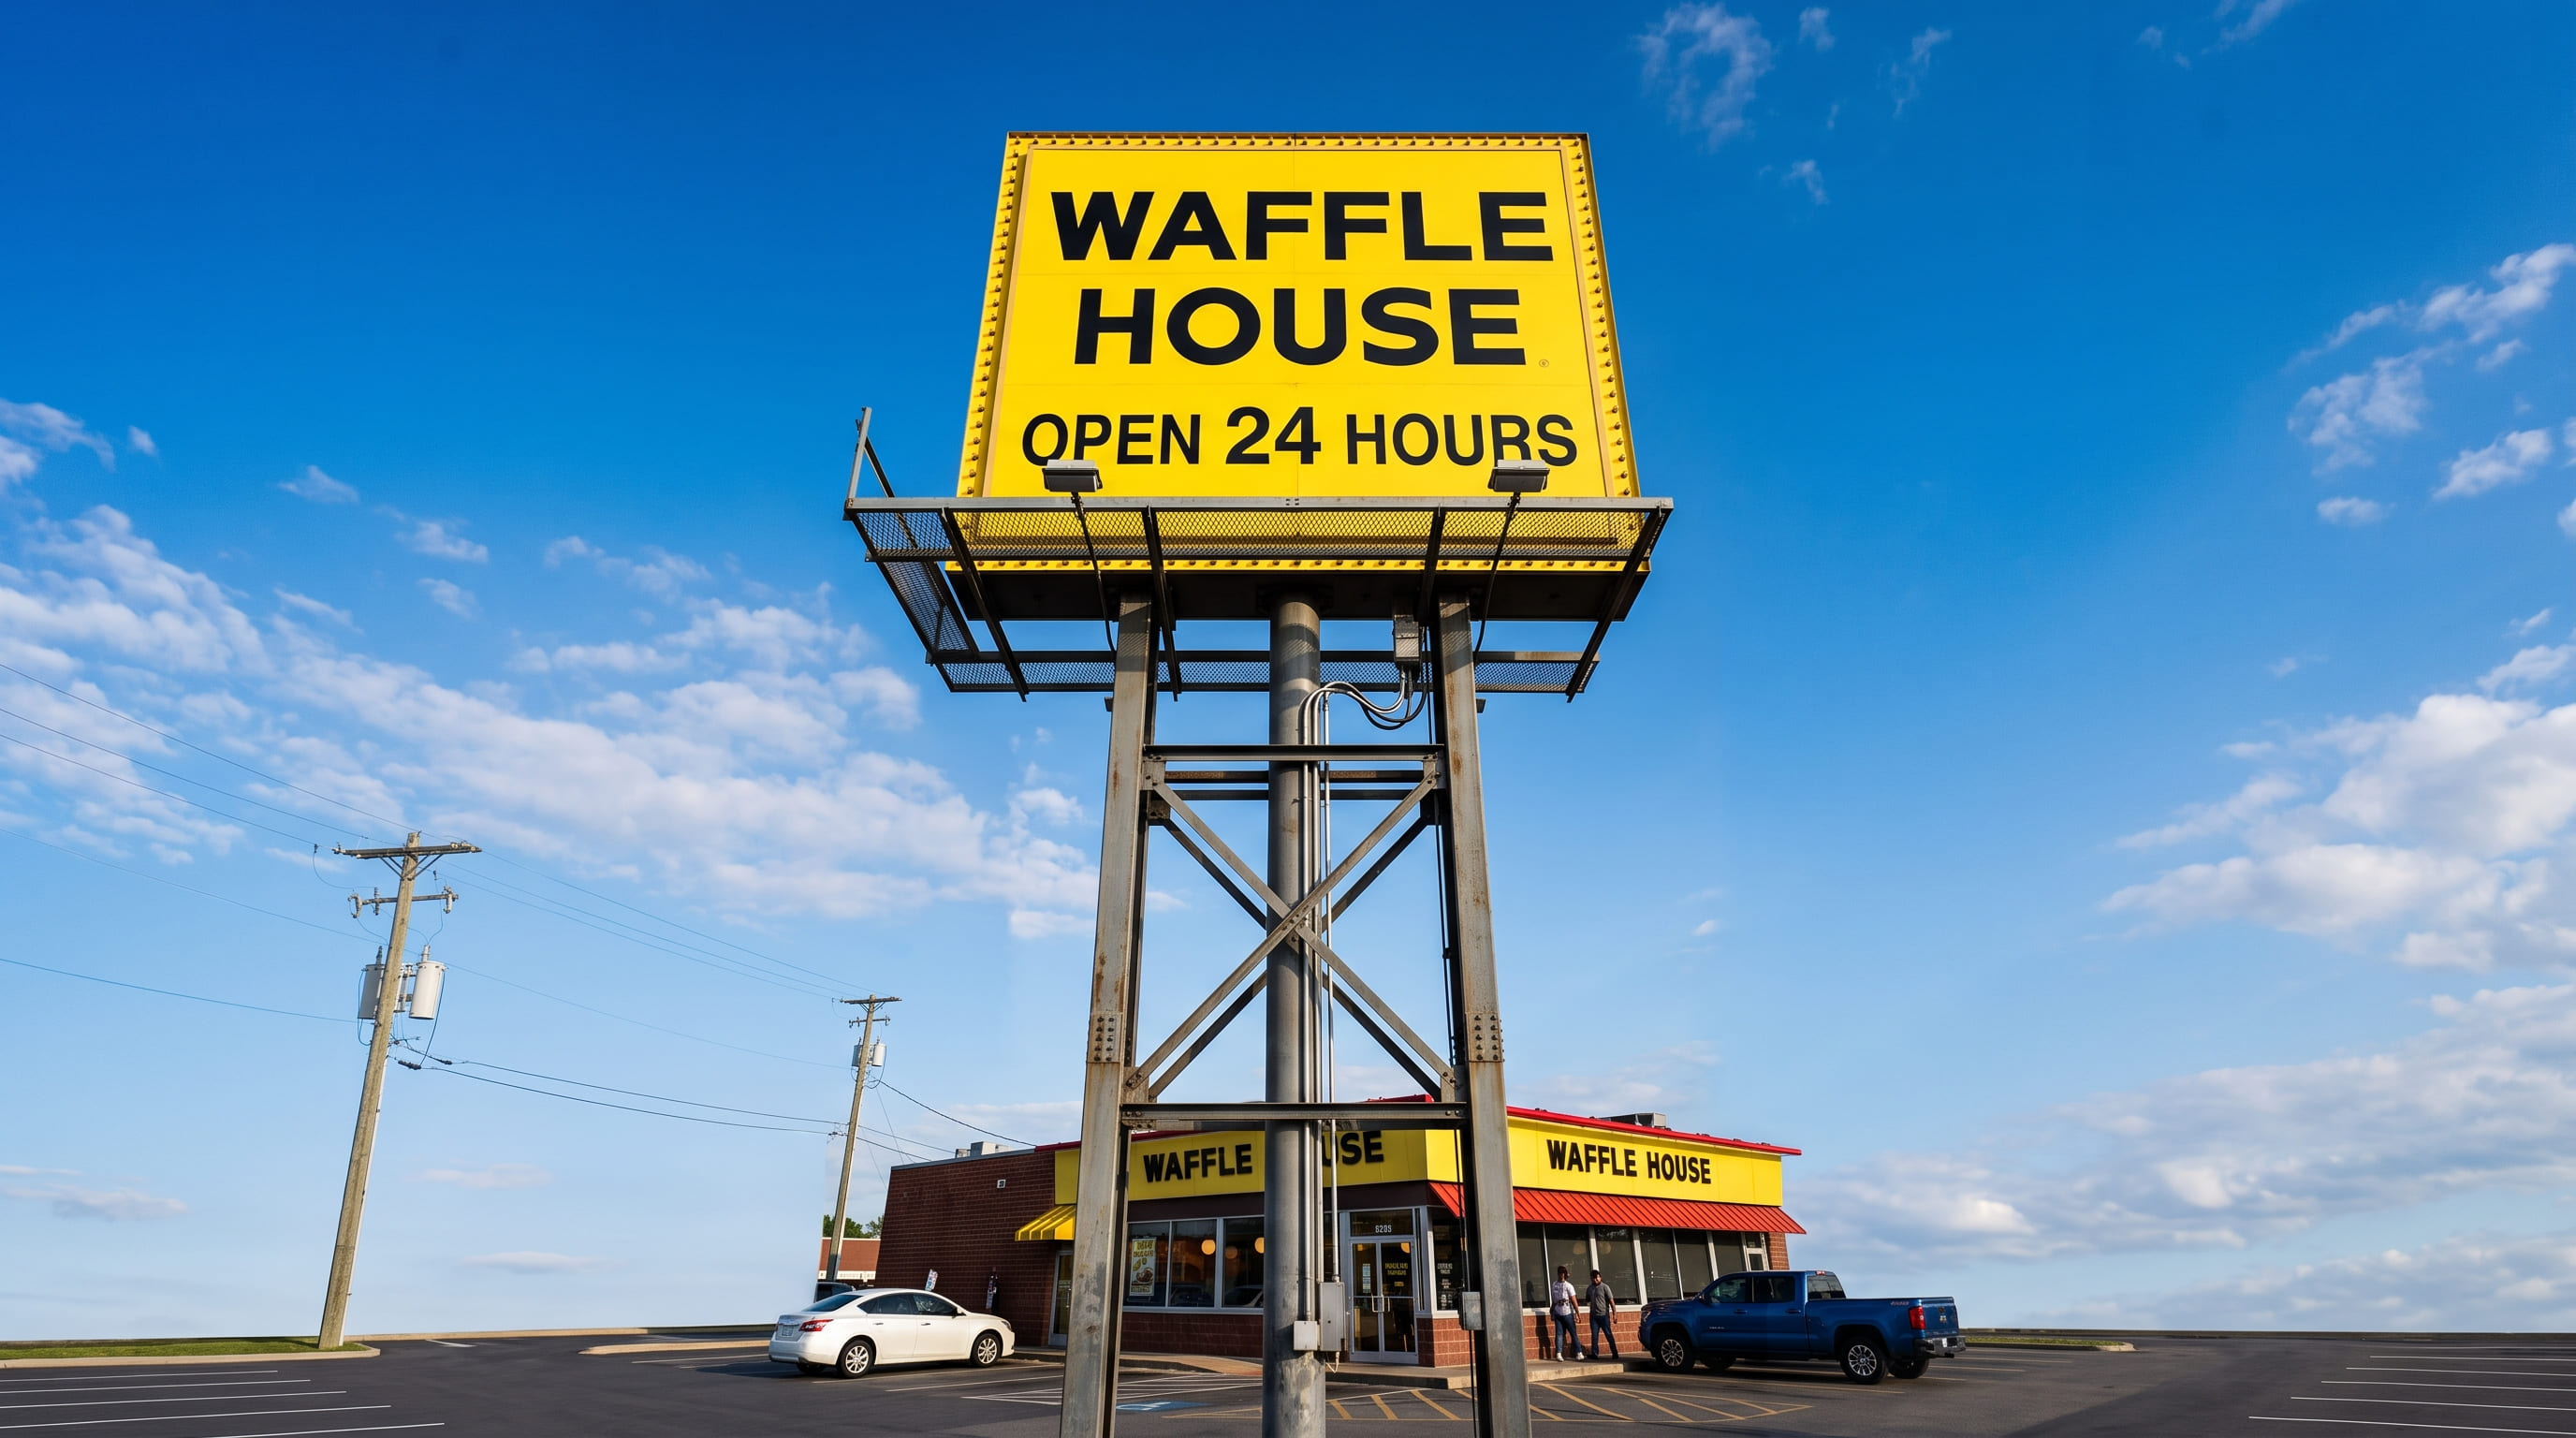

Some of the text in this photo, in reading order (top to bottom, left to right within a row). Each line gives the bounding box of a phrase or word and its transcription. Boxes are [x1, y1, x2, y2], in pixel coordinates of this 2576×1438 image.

[1050, 191, 1554, 261] WAFFLE
[1074, 286, 1527, 367] HOUSE
[1022, 406, 1577, 466] OPEN 24 HOURS
[1143, 1130, 1384, 1183] WAFFLE USE
[1546, 1138, 1711, 1184] WAFFLE HOUSE
